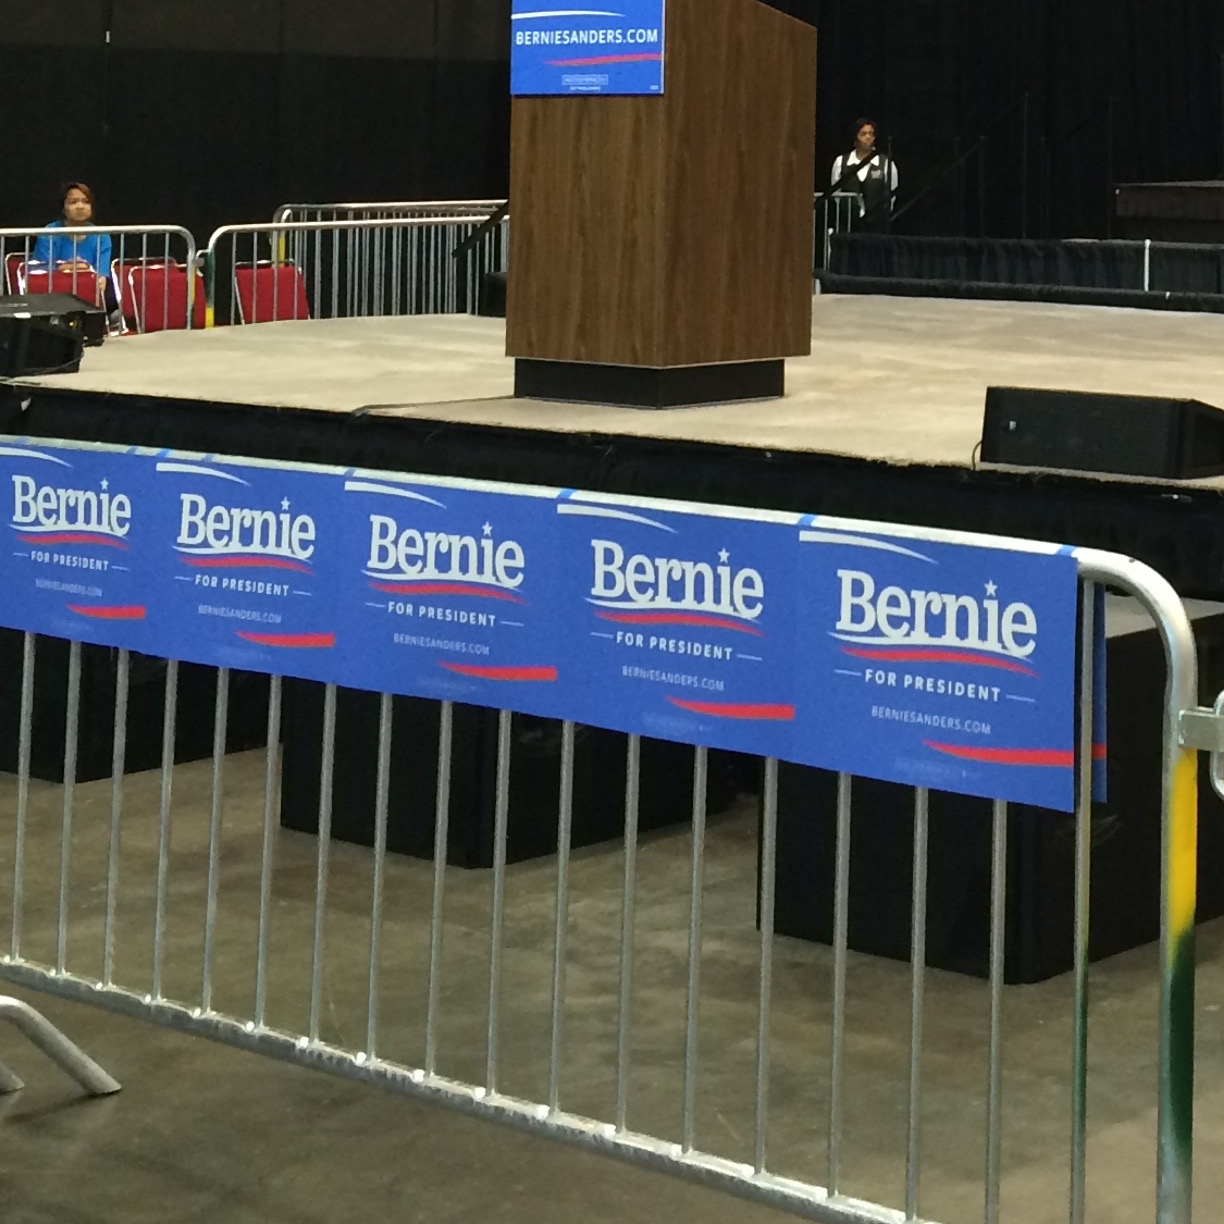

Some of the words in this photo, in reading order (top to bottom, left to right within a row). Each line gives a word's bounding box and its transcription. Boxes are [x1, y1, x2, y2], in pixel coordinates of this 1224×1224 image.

[515, 29, 658, 45] BERNIESANDERS.COM
[12, 475, 132, 538] Bernie
[177, 493, 316, 560] Bernie
[31, 550, 50, 563] FOR
[53, 553, 109, 571] PRESIDENT
[367, 514, 525, 588] Bernie
[195, 574, 217, 588] FOR
[222, 577, 289, 597] PRESIDENT
[591, 539, 764, 619] Bernie
[387, 601, 413, 616] FOR
[419, 605, 496, 627] PRESIDENT
[836, 569, 1038, 658] Bernie
[393, 632, 490, 656] BERNIESANDERS.COM
[616, 631, 644, 648] FOR
[649, 636, 733, 661] PRESIDENT
[622, 665, 725, 692] BERNIESANDERS.COM
[865, 668, 897, 687] FOR
[903, 674, 1001, 702] PRESIDENT
[871, 704, 992, 735] BERNIESANDERS.COM
